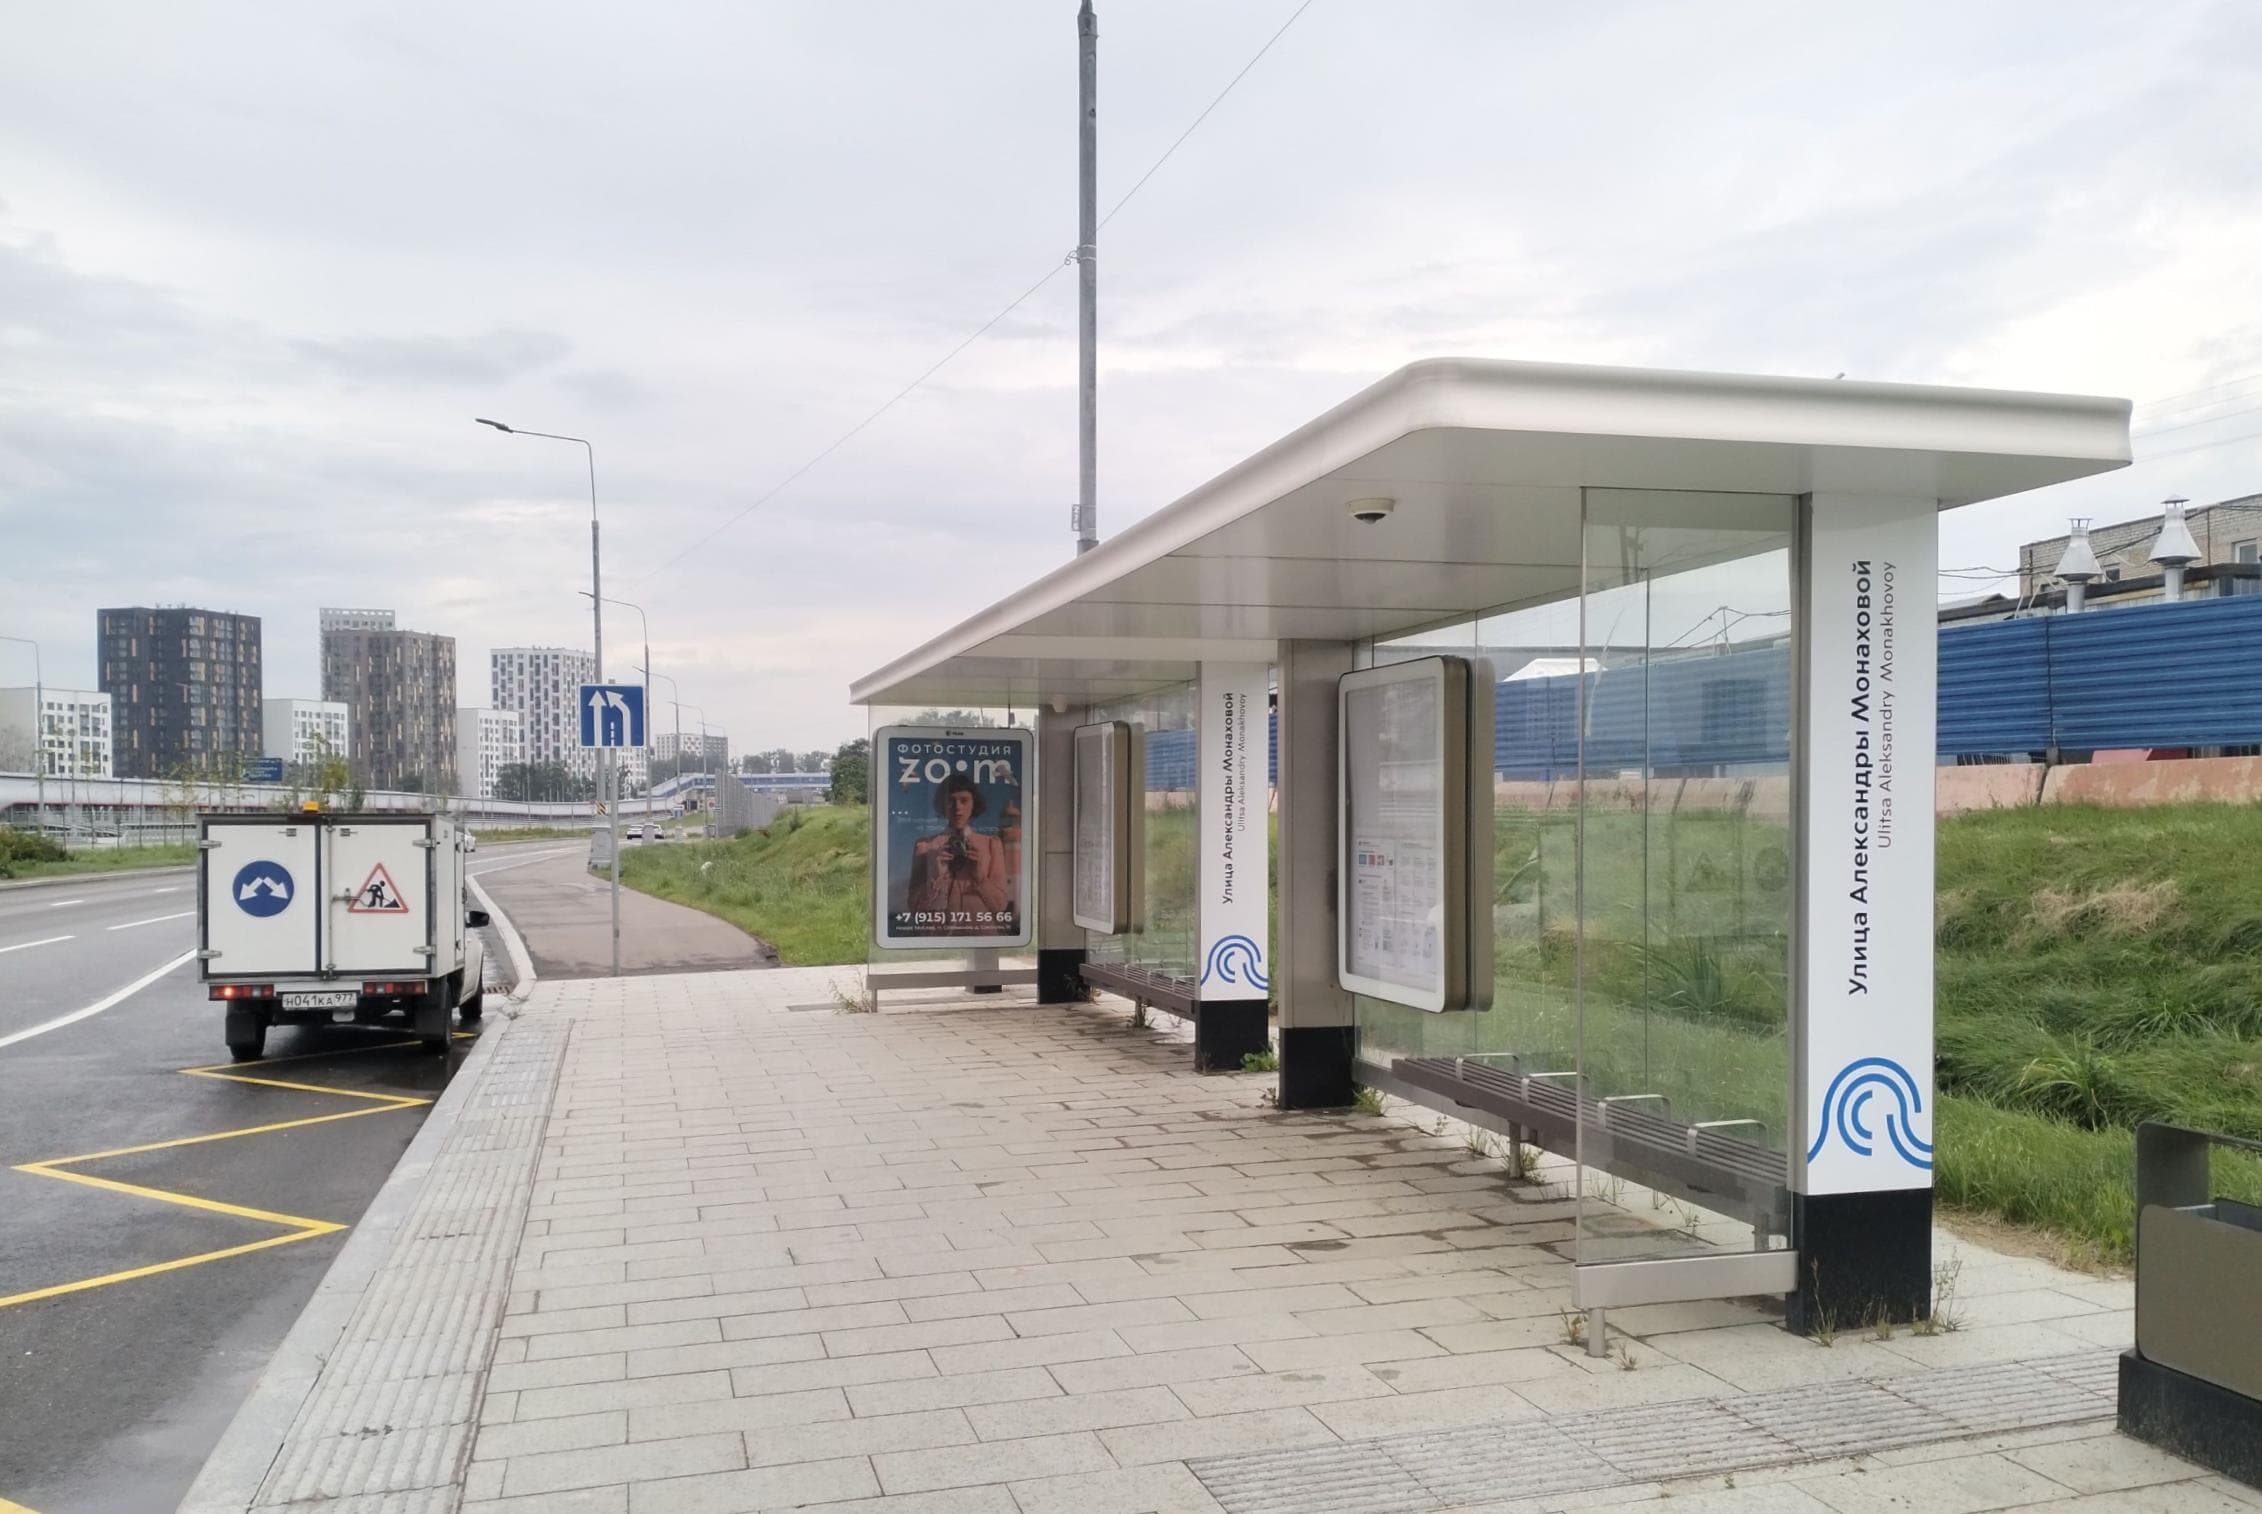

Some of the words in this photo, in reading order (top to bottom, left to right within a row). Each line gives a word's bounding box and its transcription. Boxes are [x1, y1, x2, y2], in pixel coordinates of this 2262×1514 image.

[1851, 560, 1871, 722] Монаховой
[1879, 561, 1896, 682] Monakhovoy
[897, 743, 1012, 756] ФОТОСТУДИЯ
[1222, 692, 1233, 772] Монаховой
[1878, 690, 1895, 792] Aleksandry
[1222, 776, 1235, 860] Александры
[1850, 731, 1873, 904] Александры
[1878, 797, 1892, 848] Ulitsa
[895, 912, 911, 923] +7
[914, 911, 946, 924] (915)
[950, 912, 972, 922] 171
[975, 912, 993, 922] 56
[995, 912, 1013, 922] 66
[1222, 863, 1234, 904] Улица
[1849, 912, 1870, 995] Улица
